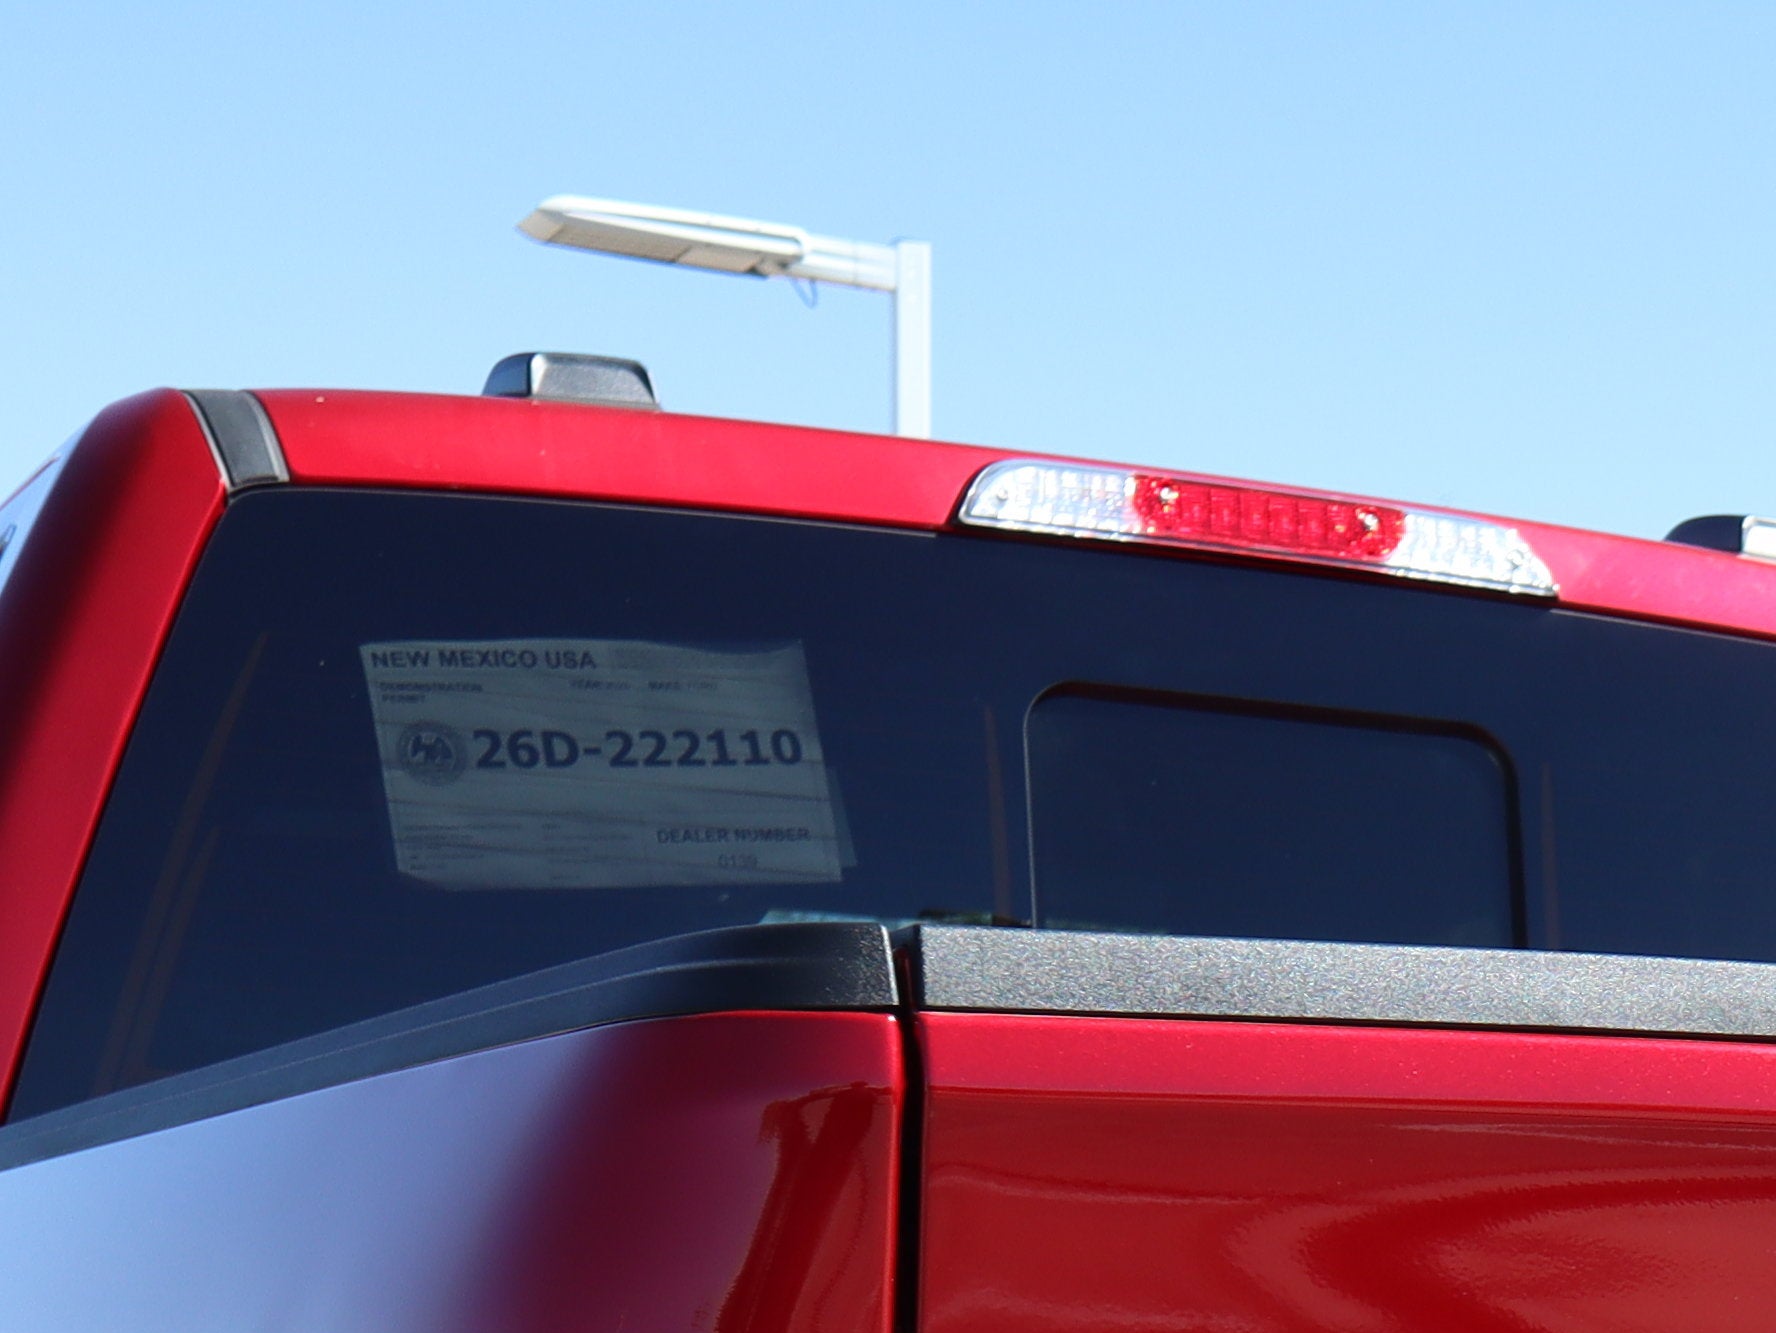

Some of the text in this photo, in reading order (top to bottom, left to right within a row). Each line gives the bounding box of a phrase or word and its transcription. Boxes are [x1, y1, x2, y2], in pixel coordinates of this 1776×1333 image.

[371, 650, 597, 670] NEW MEXICO USA
[471, 728, 802, 769] 26D-222110
[656, 827, 811, 843] DEALER NUMBER
